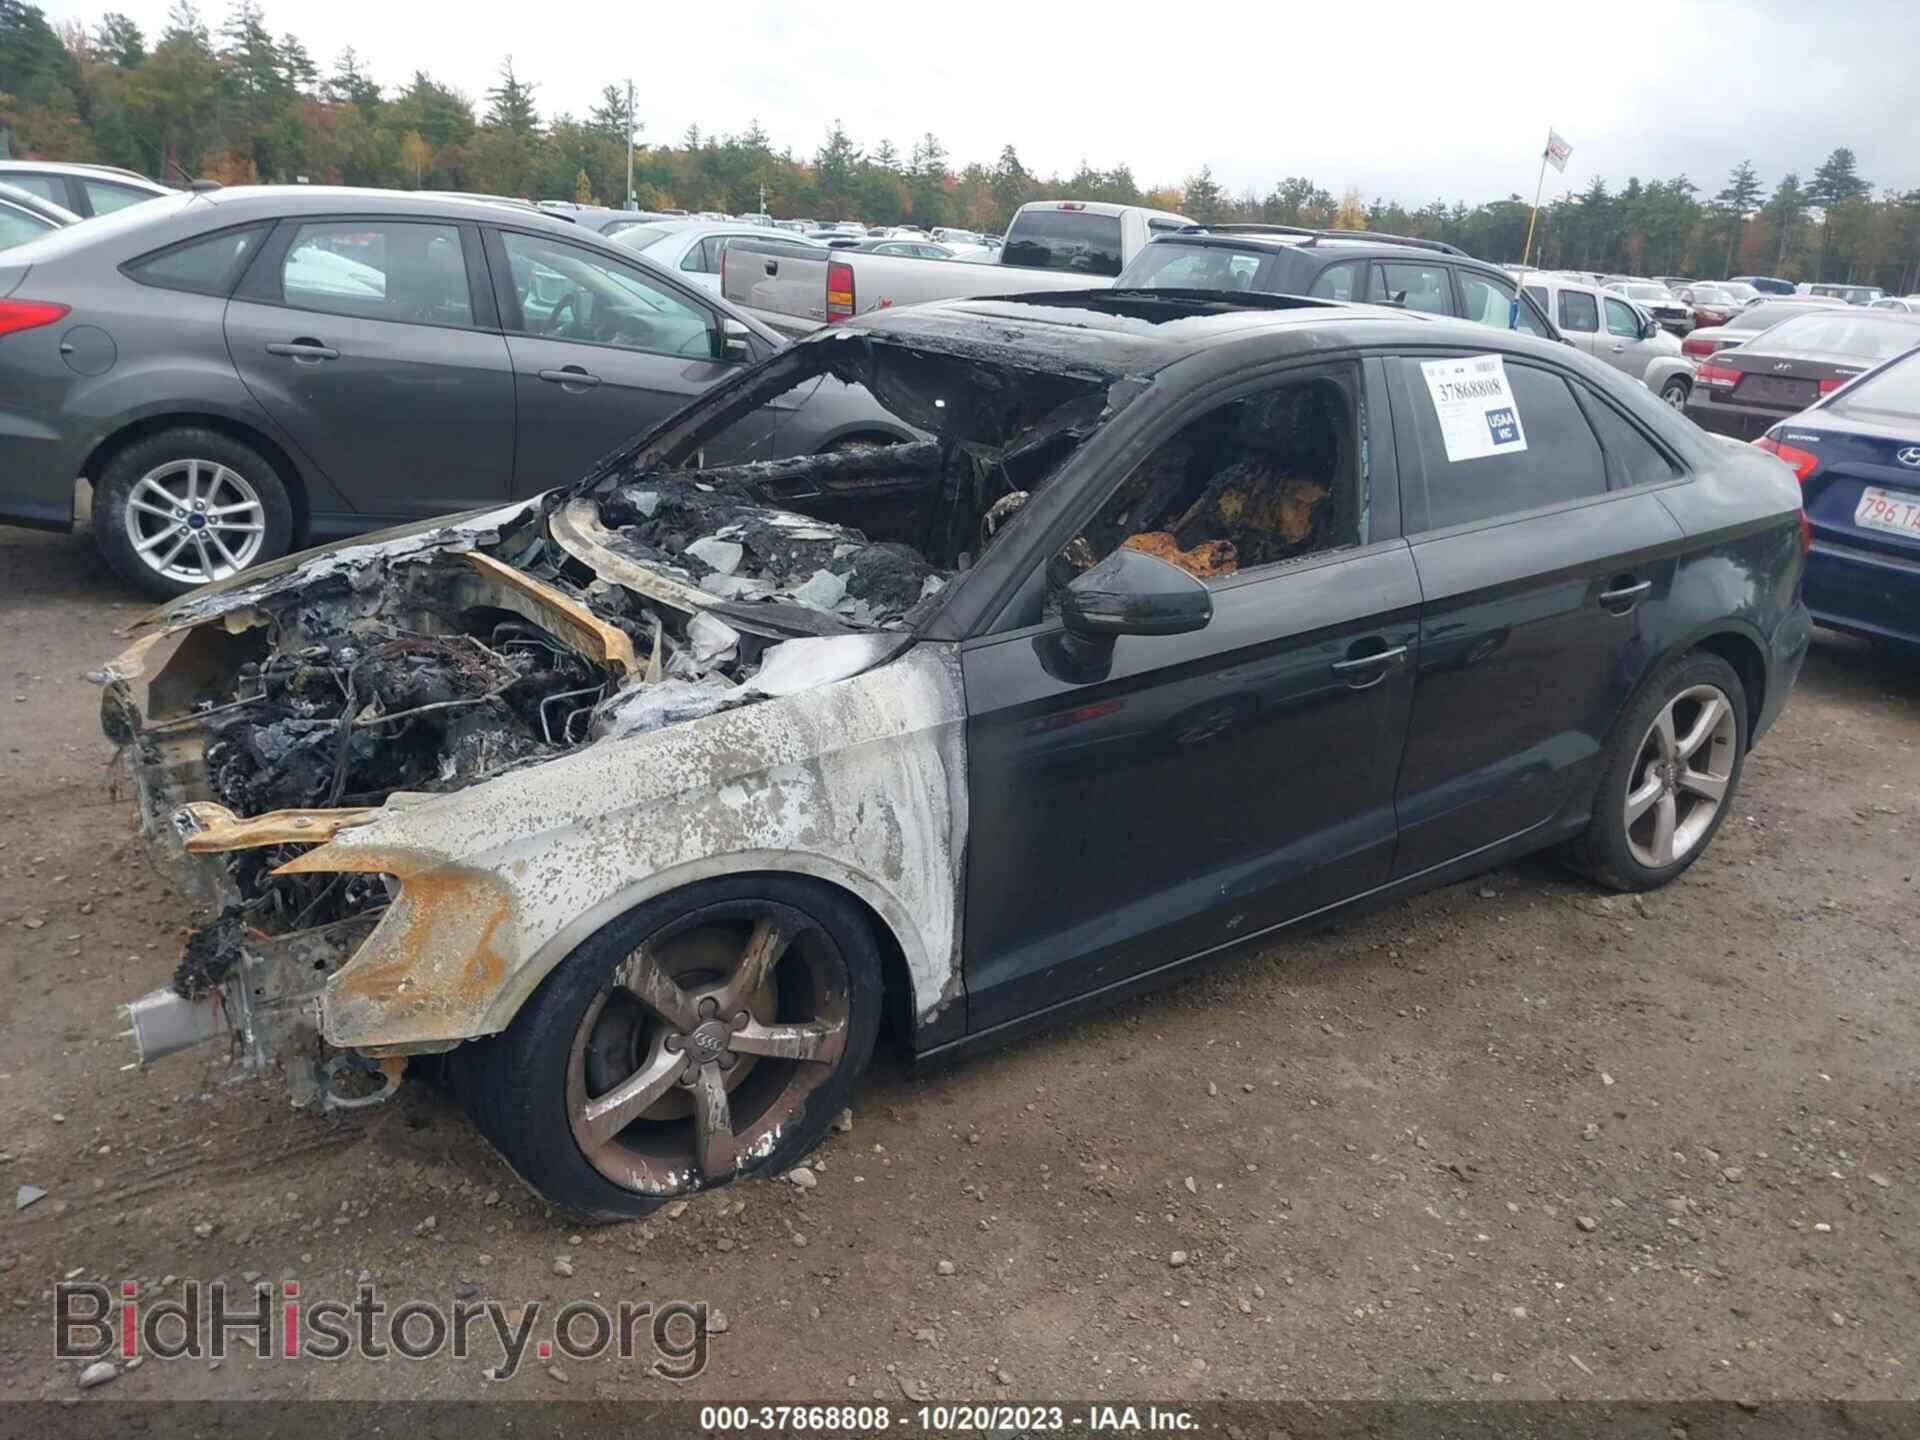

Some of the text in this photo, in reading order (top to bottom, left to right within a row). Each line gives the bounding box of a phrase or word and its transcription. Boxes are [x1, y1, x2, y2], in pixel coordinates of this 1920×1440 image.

[1438, 377, 1502, 402] 37868808
[1488, 412, 1514, 428] USAA
[1859, 497, 1899, 522] 796
